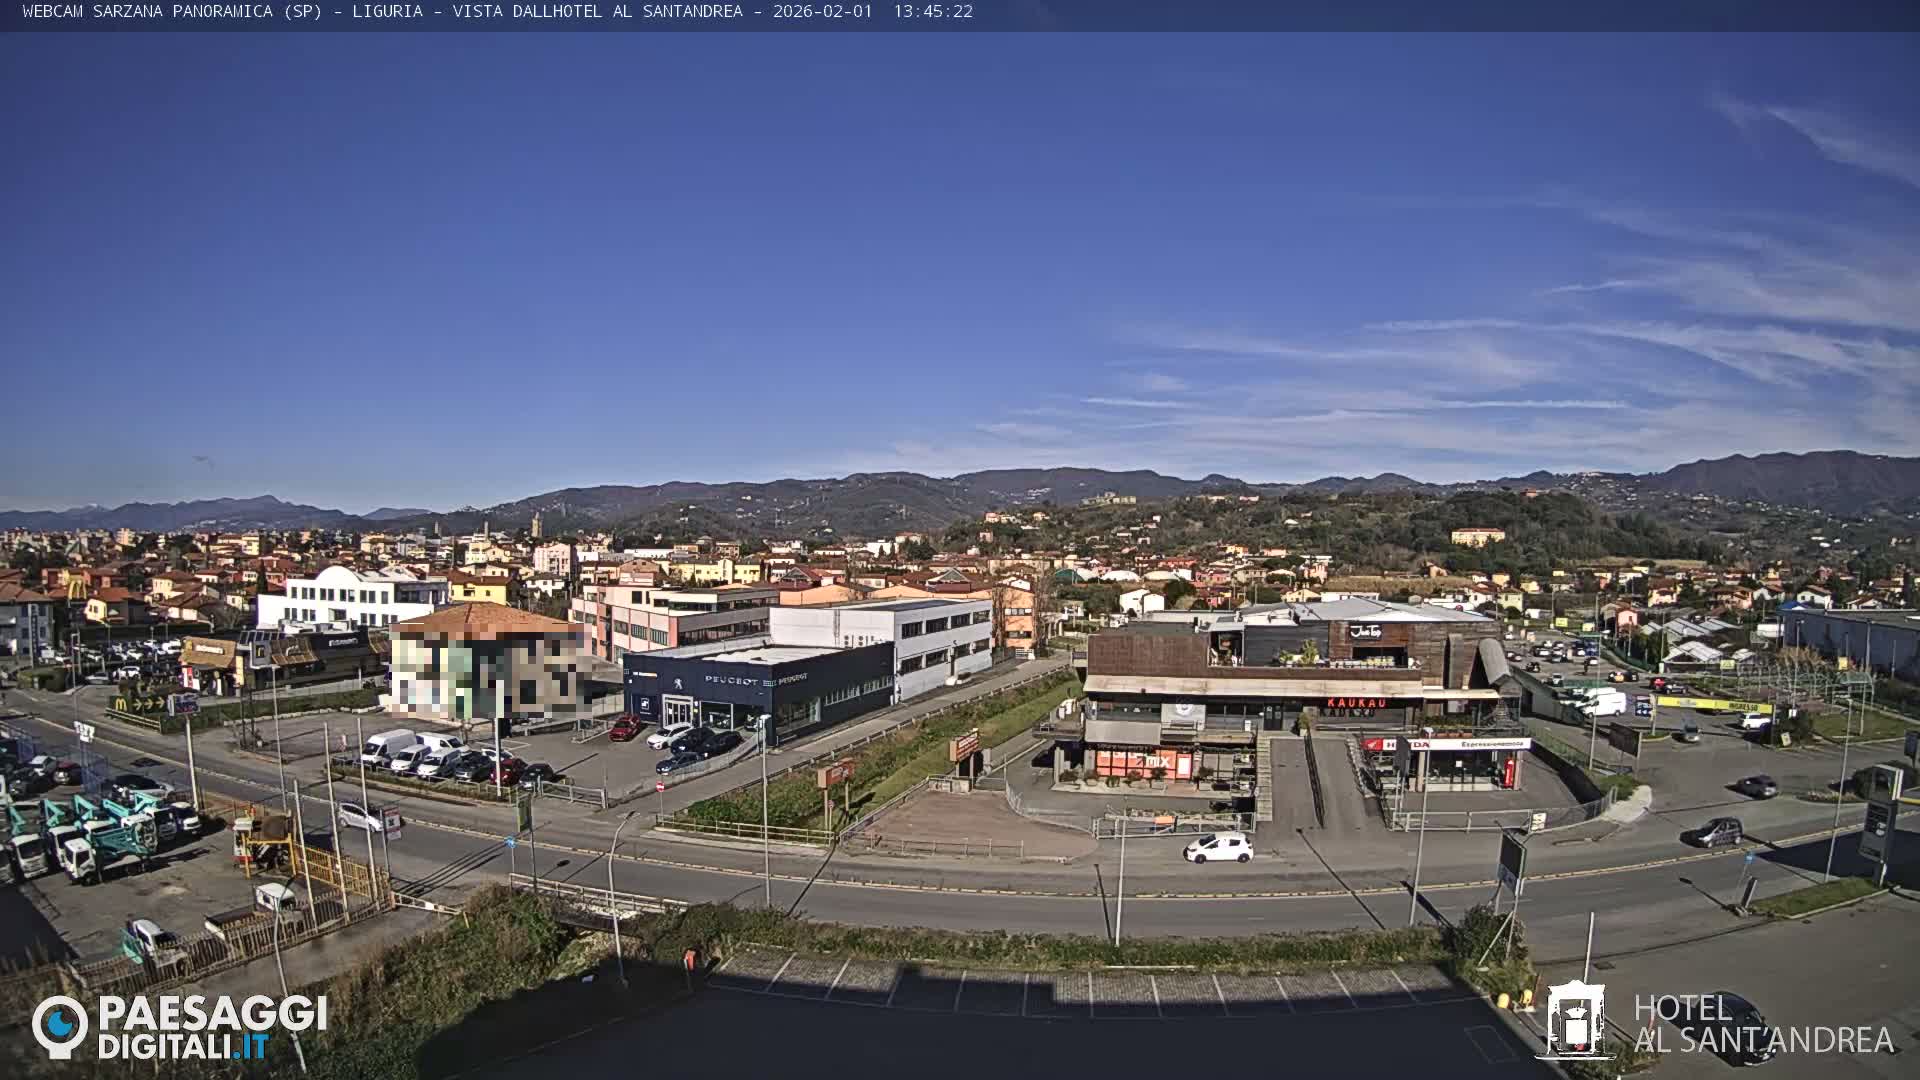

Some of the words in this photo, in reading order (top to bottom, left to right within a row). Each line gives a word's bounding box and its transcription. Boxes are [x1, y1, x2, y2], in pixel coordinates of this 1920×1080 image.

[705, 675, 758, 686] PEUGEOT
[1327, 697, 1386, 708] KAUKAU
[1386, 741, 1430, 749] HDA
